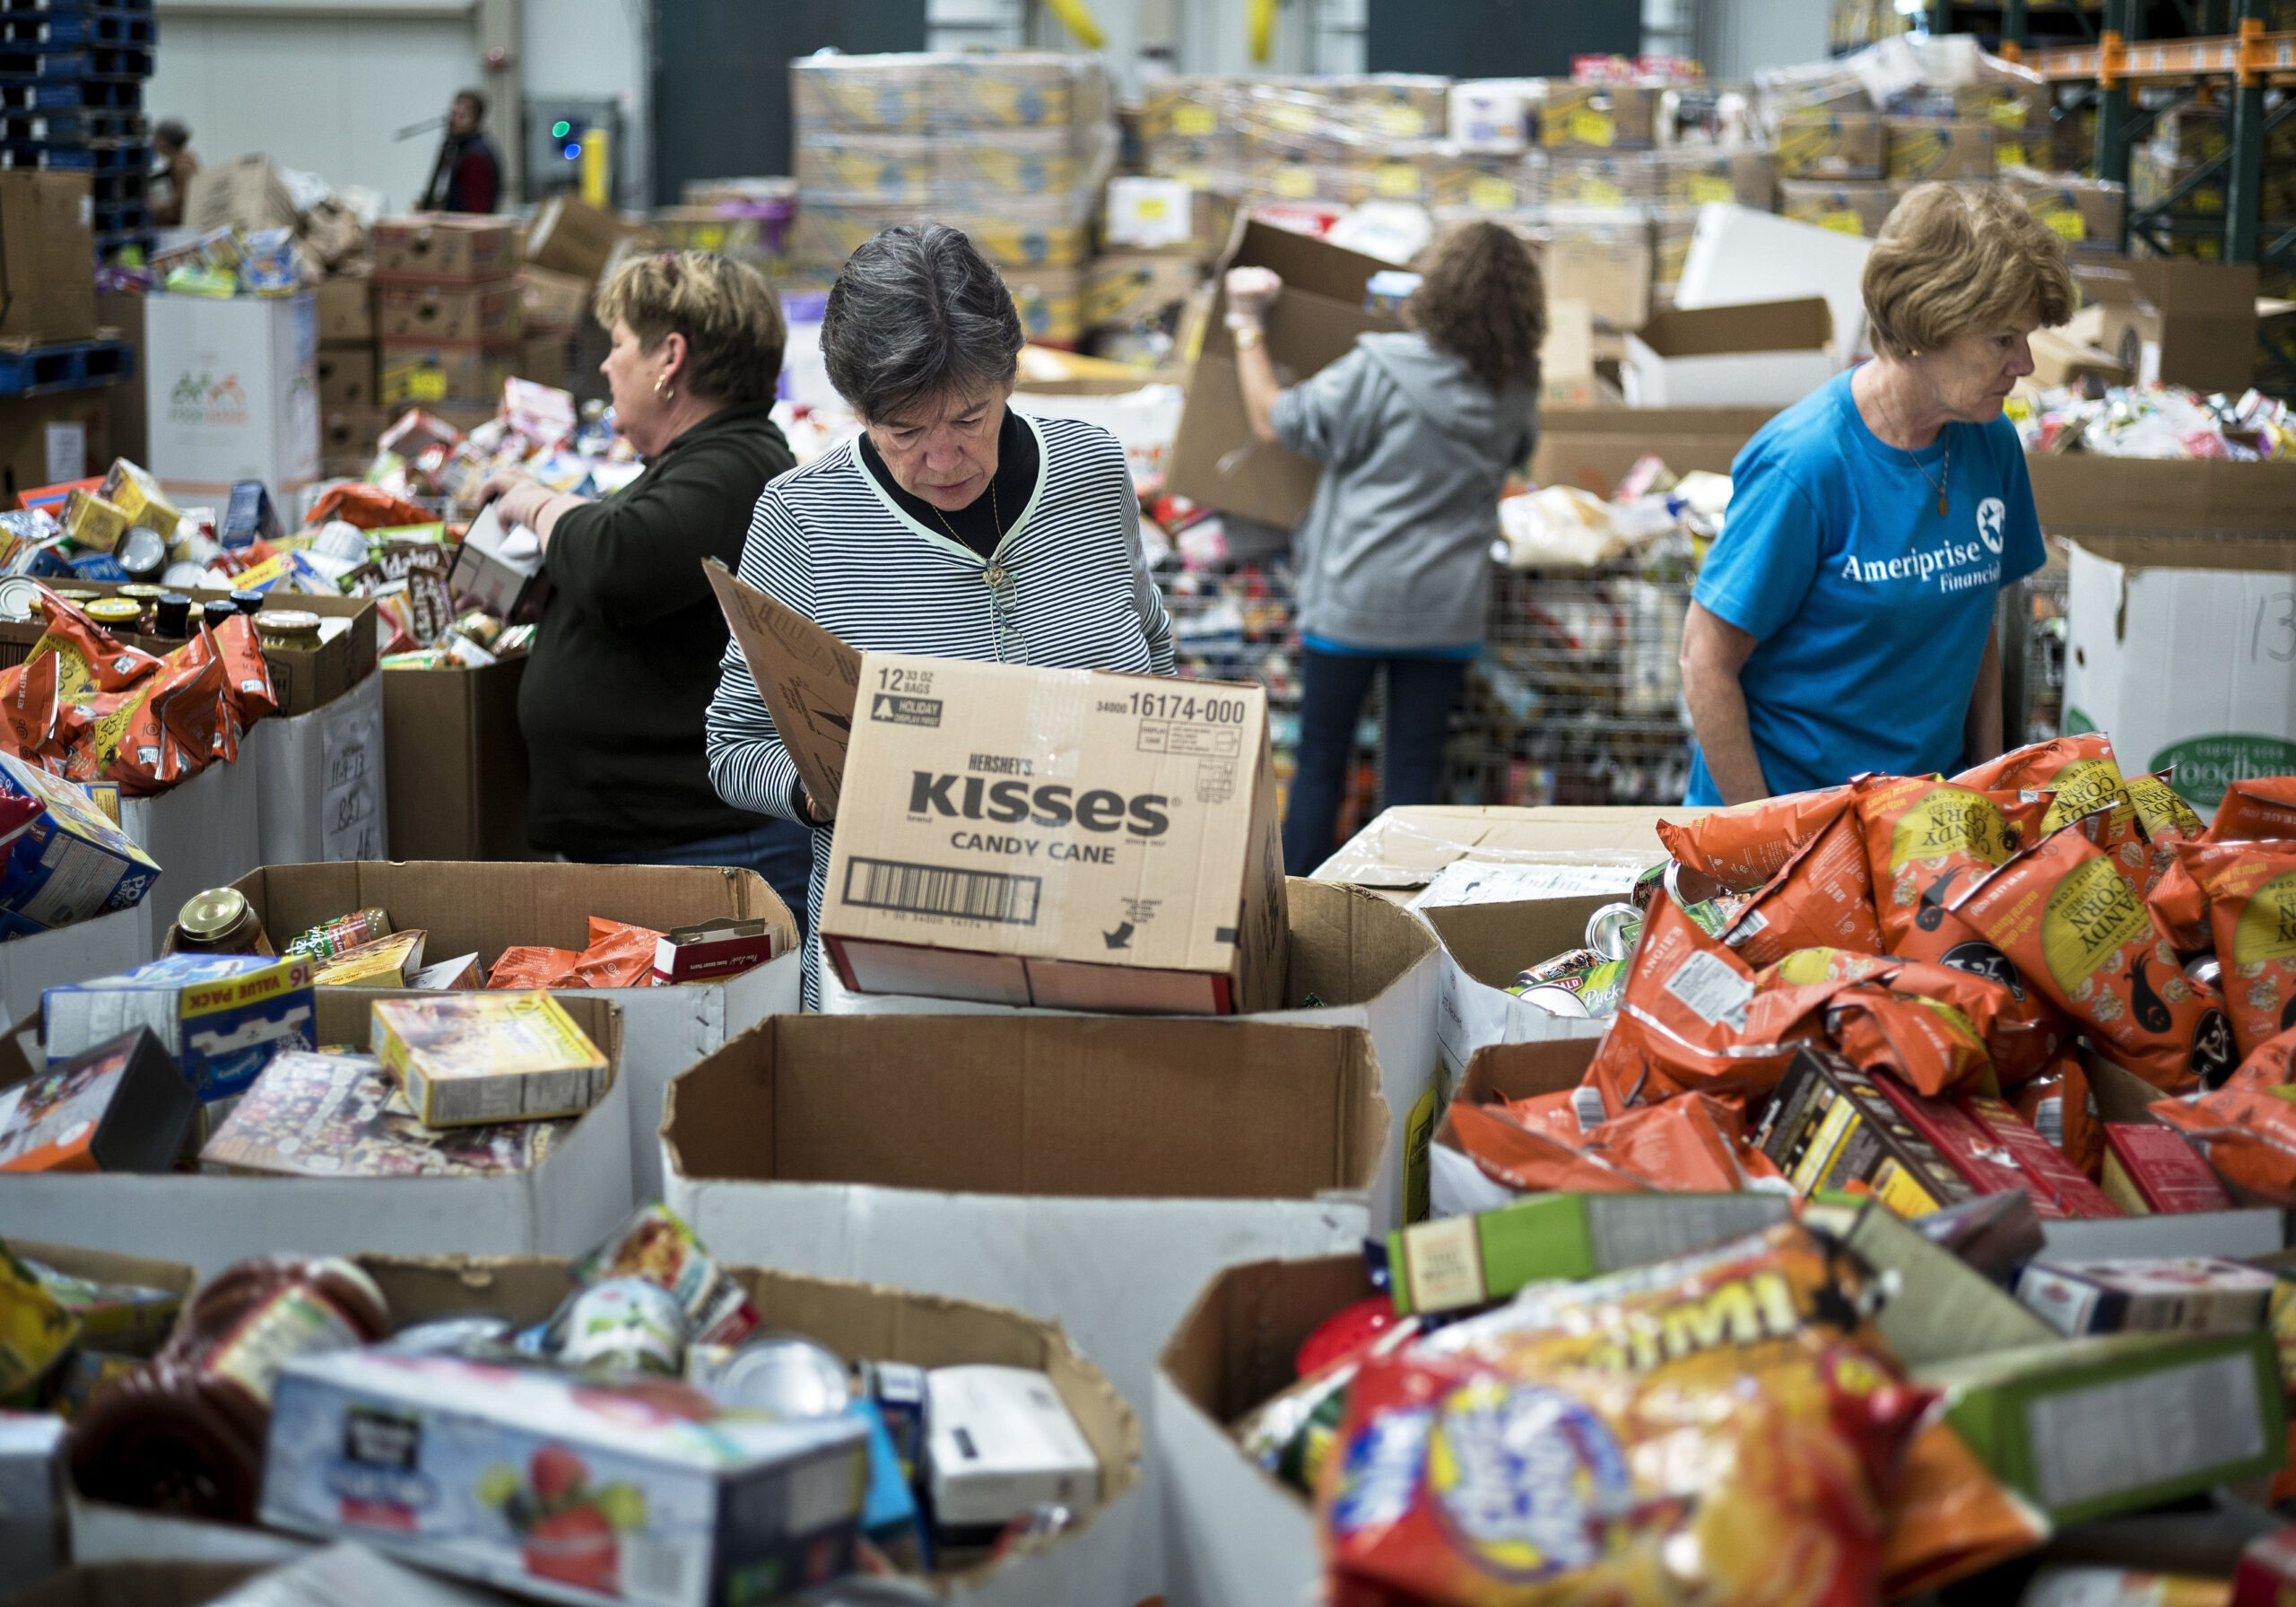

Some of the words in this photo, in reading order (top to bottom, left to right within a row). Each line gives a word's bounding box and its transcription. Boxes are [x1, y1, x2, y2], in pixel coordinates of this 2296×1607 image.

[1841, 539, 1981, 582] Ameriprise
[1940, 560, 2001, 594] Financial
[879, 667, 903, 691] 12
[904, 682, 930, 694] BAGS
[905, 670, 917, 681] 33
[921, 672, 934, 682] OZ
[899, 700, 939, 715] HOLIDAY
[1096, 700, 1127, 714] 34000
[1130, 692, 1245, 724] 16174-000
[2069, 760, 2102, 777] KETTLE
[1866, 792, 1892, 810] flavors
[1892, 781, 1924, 797] natural
[1924, 792, 1954, 803] CORN
[2057, 777, 2115, 807] CORN
[2136, 788, 2174, 806] ORN
[1886, 798, 1907, 811] with
[907, 814, 933, 824] brand
[951, 830, 1039, 856] CANDY
[1048, 842, 1116, 864] CANE
[2075, 857, 2108, 886] KETTLE
[2009, 890, 2039, 919] natural
[2048, 886, 2074, 912] CORN
[2062, 867, 2117, 919] FLAVORED
[2070, 875, 2127, 933] CORN
[1986, 911, 2012, 940] flavors
[2017, 914, 2035, 934] with
[2081, 899, 2135, 954] ANDY
[2111, 916, 2140, 944] SPOOKY
[729, 957, 744, 966] Look!
[744, 954, 758, 962] New
[1641, 925, 1683, 979] ANGIE'S
[239, 975, 280, 999] VALUE
[290, 965, 313, 987] 16
[190, 988, 233, 1010] PACK
